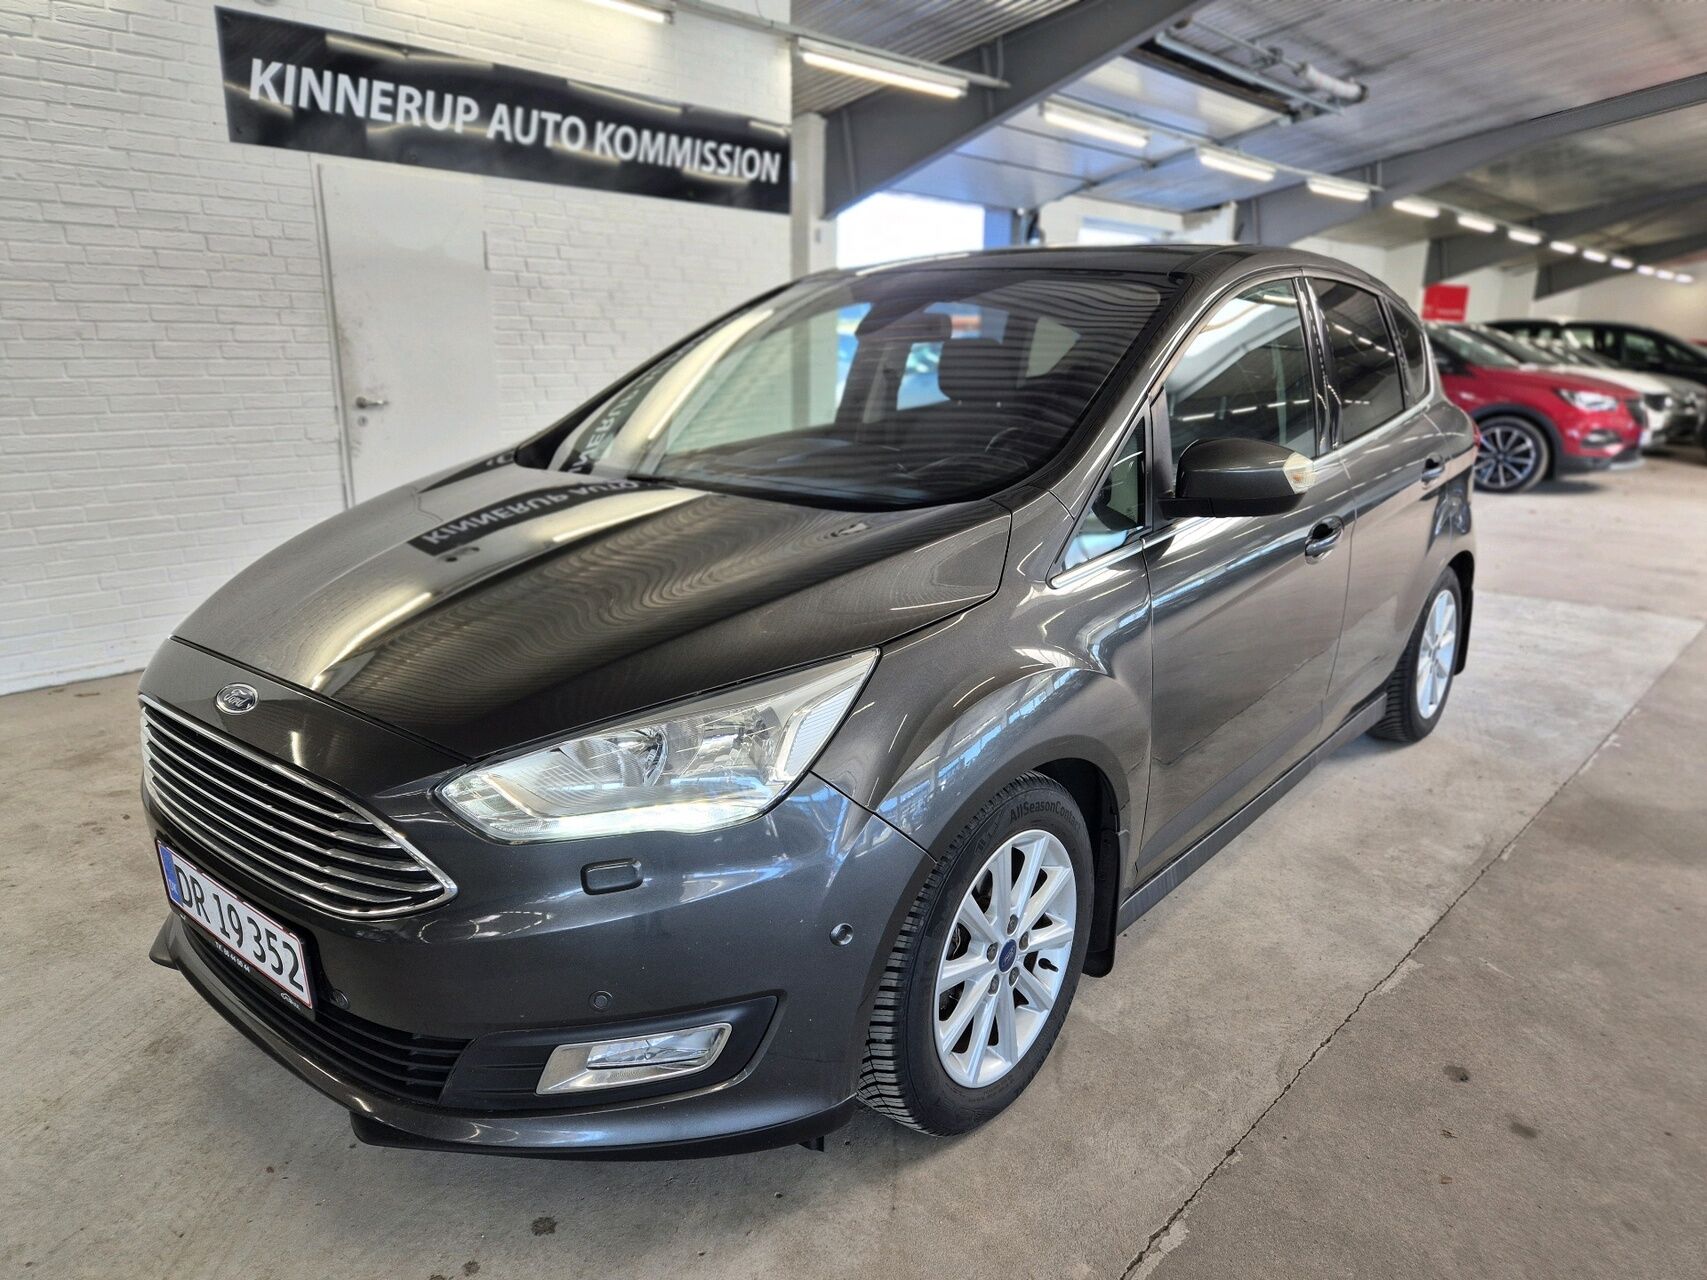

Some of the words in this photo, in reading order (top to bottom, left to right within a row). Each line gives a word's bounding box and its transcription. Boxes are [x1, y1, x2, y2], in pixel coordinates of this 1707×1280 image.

[249, 59, 480, 134] KINNERUP
[487, 104, 587, 152] AUTO
[593, 122, 782, 184] KOMMISSION
[175, 864, 211, 924] DR
[213, 894, 244, 949] 19
[247, 916, 304, 993] 352
